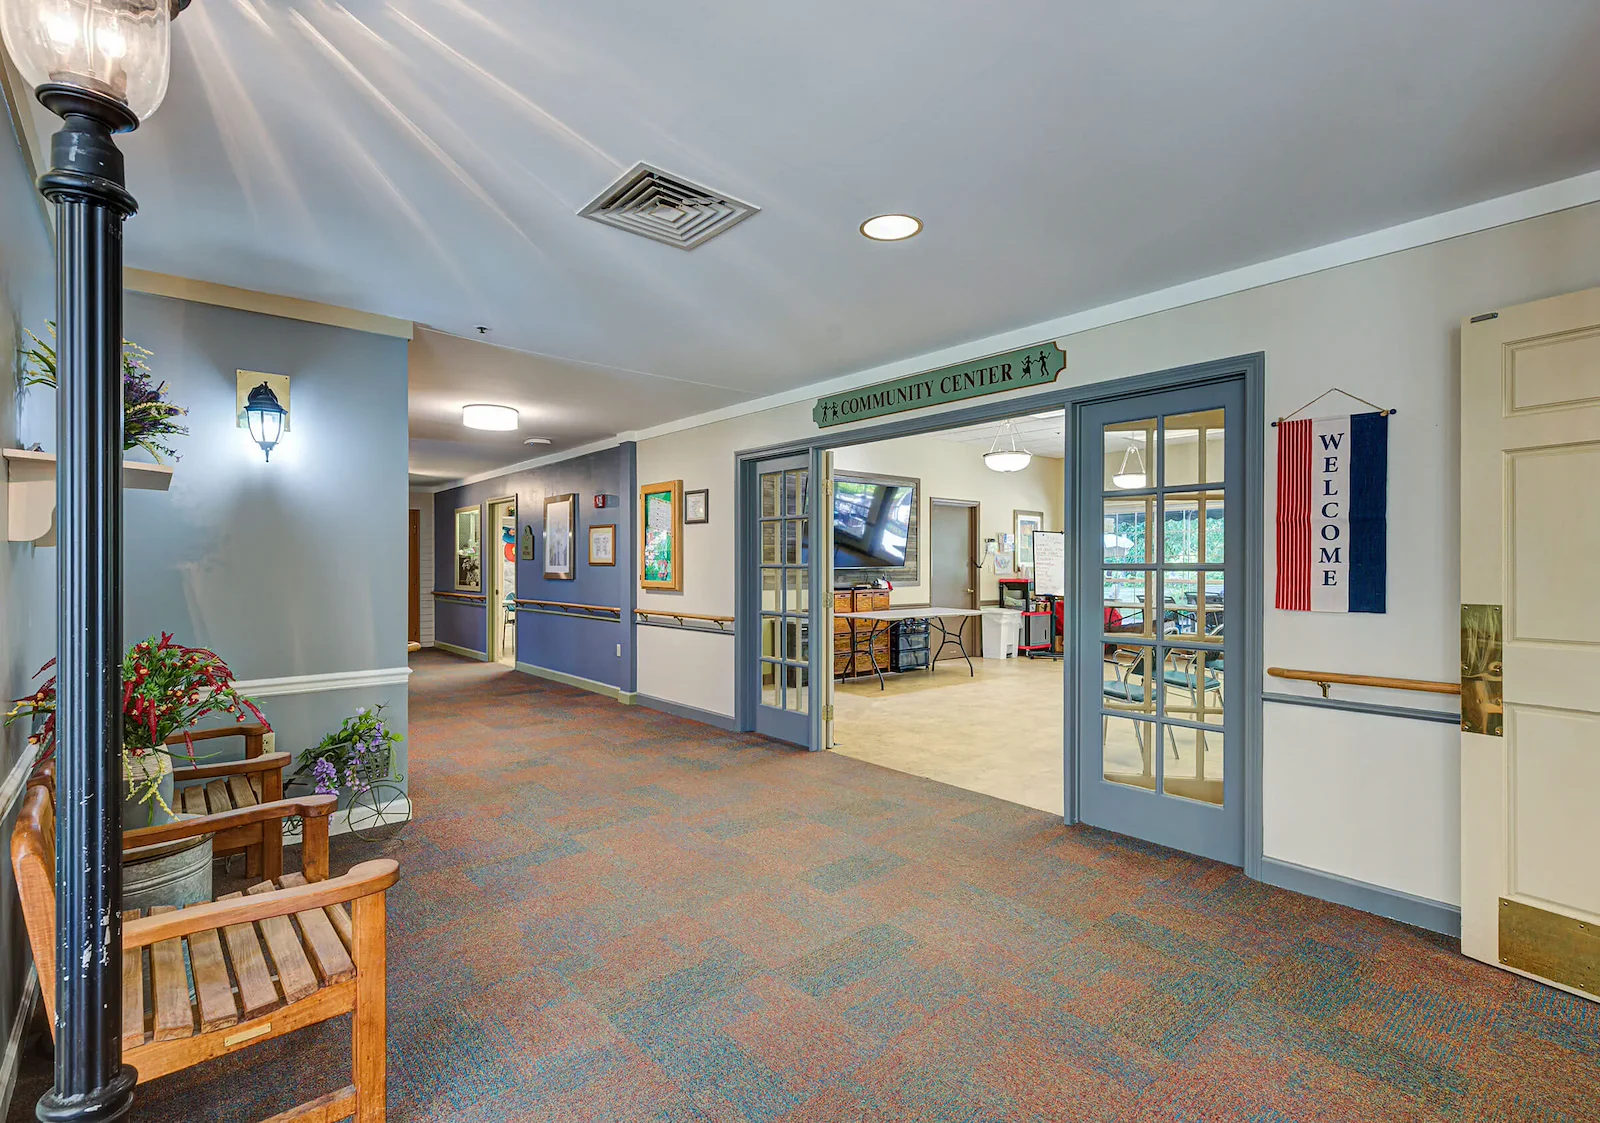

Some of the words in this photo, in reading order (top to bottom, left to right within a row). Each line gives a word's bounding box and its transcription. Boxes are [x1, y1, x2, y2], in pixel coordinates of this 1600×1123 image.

[841, 380, 934, 416] COMMUNITY
[940, 362, 1013, 394] CENTER
[1318, 432, 1345, 587] WELCOME
